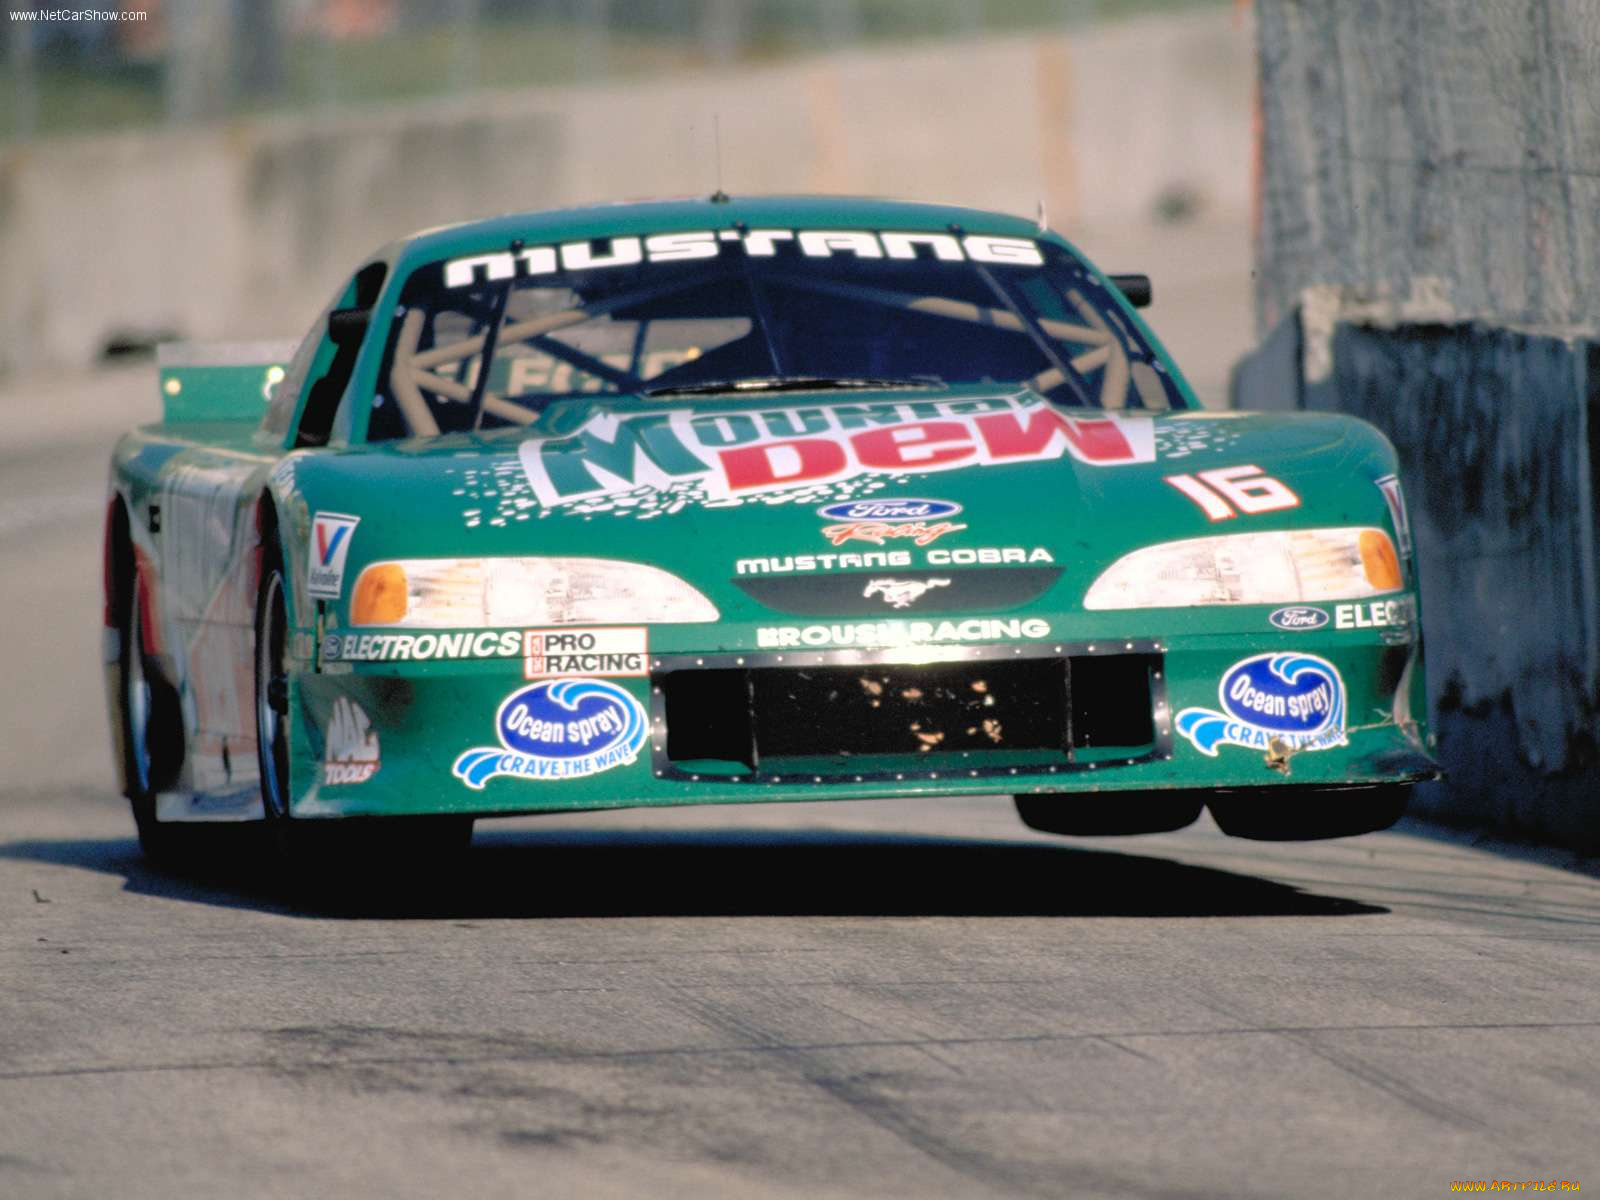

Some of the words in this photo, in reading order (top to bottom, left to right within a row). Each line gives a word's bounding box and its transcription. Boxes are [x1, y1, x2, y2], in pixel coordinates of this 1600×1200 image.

[444, 230, 1044, 289] MUSTANG
[1165, 464, 1300, 522] 16
[848, 502, 930, 516] Ford
[821, 522, 967, 545] Racing
[736, 551, 911, 574] MUSTANG
[927, 548, 1053, 564] COBRA
[910, 619, 1050, 641] RACING
[1280, 610, 1318, 626] Ford
[342, 631, 522, 661] ELECTRONICS
[545, 633, 596, 651] PRO
[546, 653, 642, 673] RACING
[1230, 674, 1285, 717] Ocean
[1287, 682, 1329, 722] spray
[506, 703, 564, 743] Ocean
[567, 705, 624, 746] spray
[500, 754, 560, 777] CRAVE
[563, 758, 592, 776] THE
[594, 743, 630, 769] WAVE
